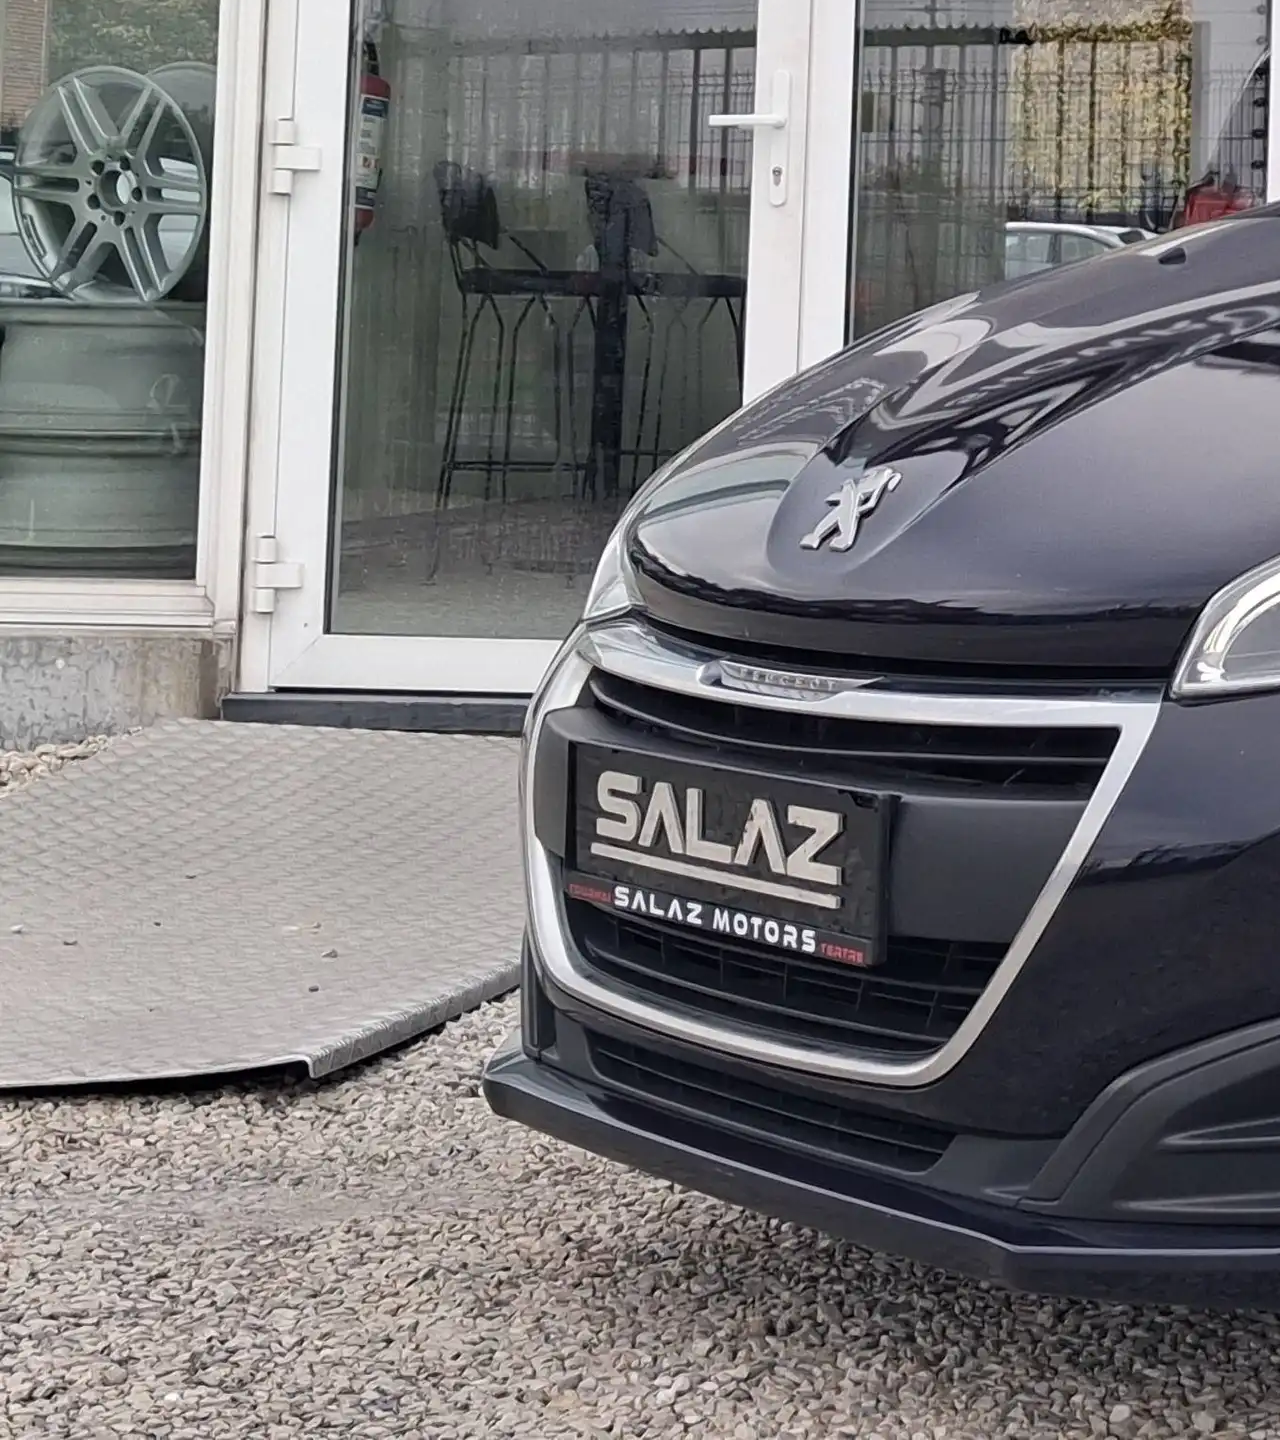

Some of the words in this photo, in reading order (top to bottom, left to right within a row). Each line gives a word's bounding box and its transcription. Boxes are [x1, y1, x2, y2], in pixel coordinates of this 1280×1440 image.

[595, 769, 846, 887] SALAZ
[613, 885, 704, 926] SALAZ
[712, 907, 817, 954] MOTORS
